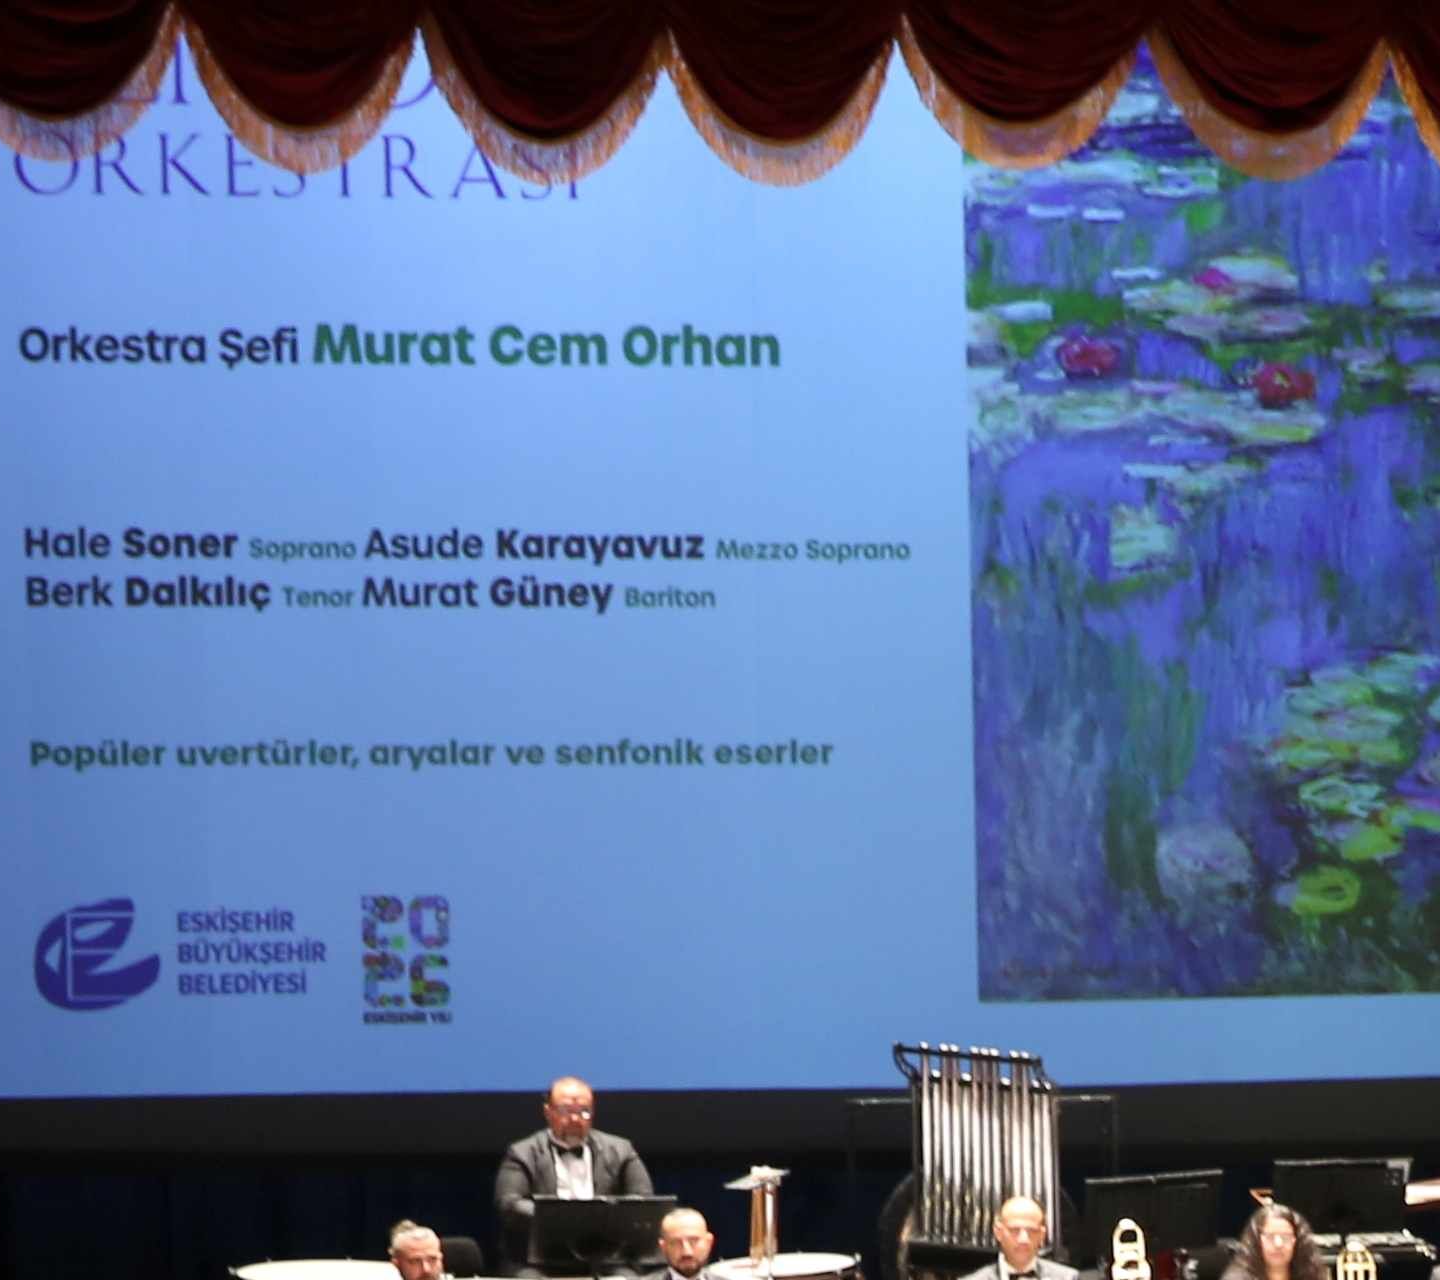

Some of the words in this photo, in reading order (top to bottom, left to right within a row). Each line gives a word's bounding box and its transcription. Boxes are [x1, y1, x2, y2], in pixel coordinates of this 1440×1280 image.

[18, 325, 208, 365] Orkestra
[218, 325, 300, 371] Şefi
[312, 322, 476, 367] Murat
[488, 324, 608, 367] Cem
[621, 323, 781, 368] Orhan
[24, 525, 112, 559] Hale
[122, 526, 239, 559] Soner
[249, 538, 357, 563] Soprano
[363, 527, 485, 561] Asude
[495, 528, 705, 567] Karayavuz
[716, 539, 799, 560] Mezzo
[805, 539, 911, 564] Soprano
[25, 575, 114, 608] Berk
[124, 574, 272, 613] Dalkılıç
[282, 586, 353, 607] Tenor
[361, 576, 480, 609] Murat
[488, 574, 615, 616] Güney
[624, 586, 716, 609] Bariton
[29, 739, 167, 773] Popüler
[175, 738, 361, 770] uvertürler,
[368, 738, 496, 772] aryalar
[503, 743, 546, 767] ve
[554, 737, 705, 767] senfonik
[713, 738, 835, 766] eserler
[175, 906, 295, 938] ESKİŞEHİR
[176, 935, 327, 966] BÜYÜKŞEHİR
[177, 967, 308, 997] BELEDİYESİ
